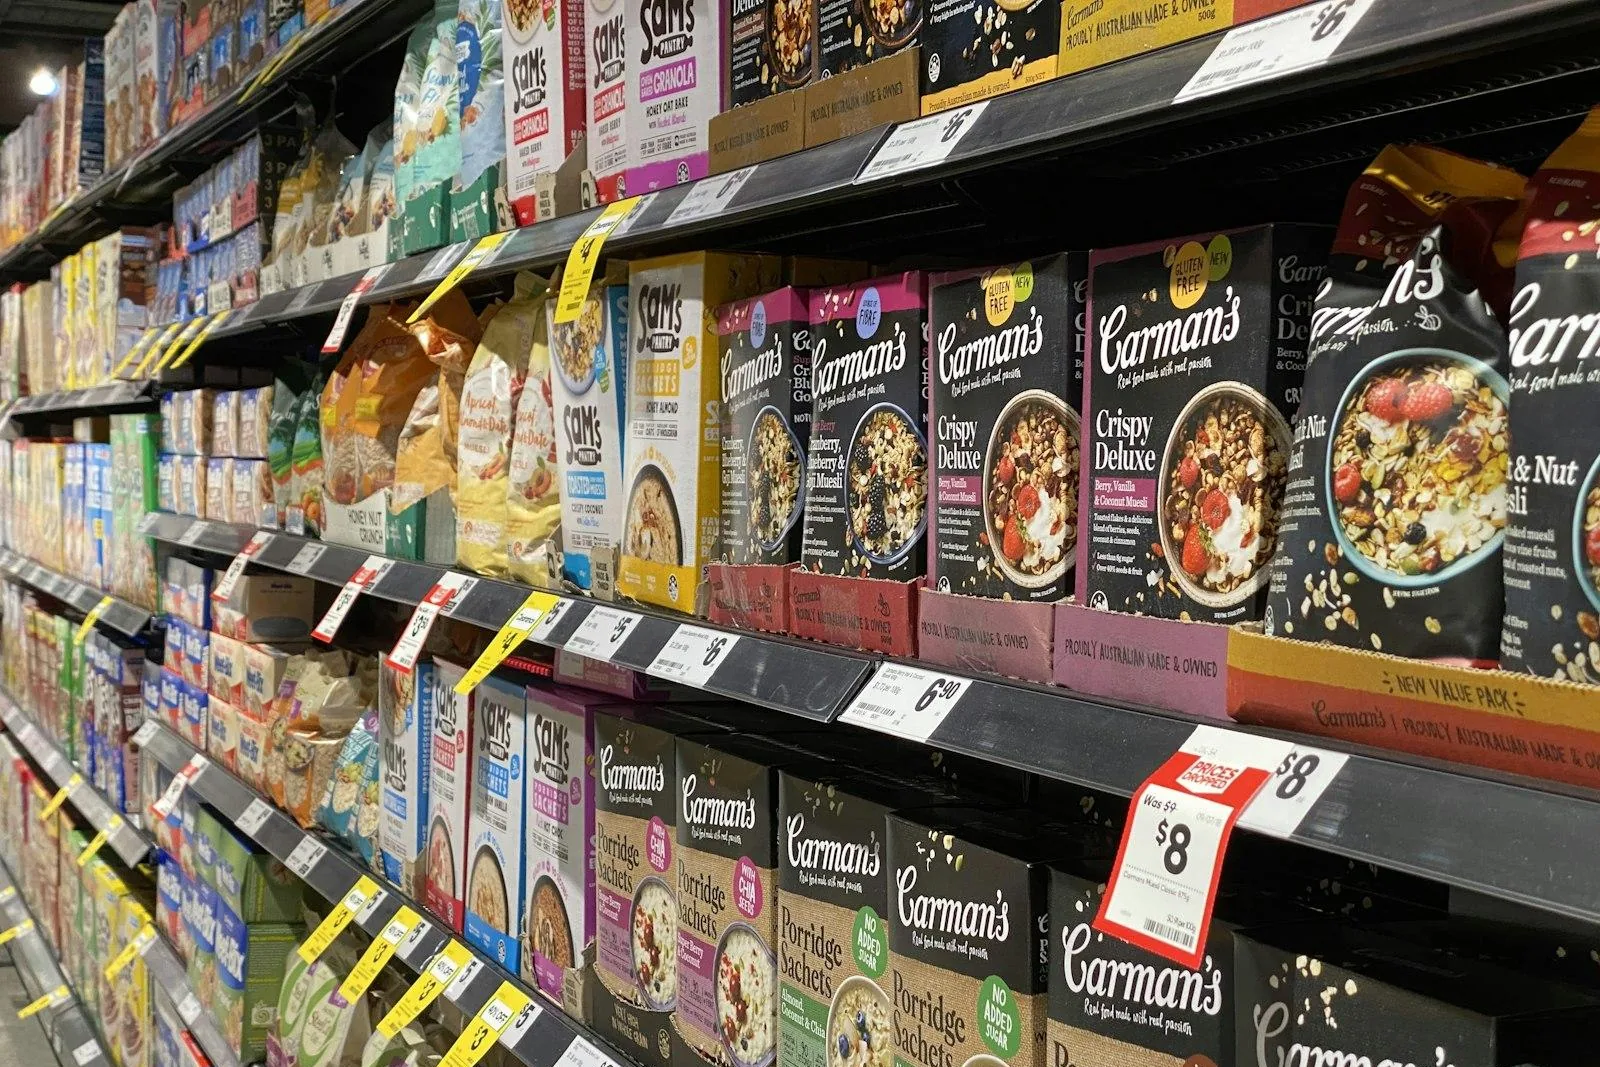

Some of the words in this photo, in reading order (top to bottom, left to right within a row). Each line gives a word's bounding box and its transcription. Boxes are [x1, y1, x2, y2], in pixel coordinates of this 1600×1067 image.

[1066, 25, 1093, 50] PROUDLY
[1096, 11, 1143, 41] AUSTRALIAN
[1144, 3, 1168, 25] MADE
[1171, 2, 1179, 16] &
[1197, 9, 1216, 22] 500g
[1310, 0, 1355, 42] $6
[660, 36, 685, 56] PANTRY
[653, 61, 694, 94] GRANOLA
[947, 90, 972, 107] Australian
[972, 86, 986, 99] made
[992, 79, 1011, 94] owned
[941, 108, 974, 143] $6
[1174, 255, 1204, 278] GLUTEN
[1209, 251, 1228, 266] NEW
[988, 280, 1011, 298] GLUTEN
[1014, 275, 1032, 289] NEW
[1175, 274, 1200, 297] FREE
[859, 310, 878, 328] FIBRE
[989, 295, 1009, 316] FREE
[1099, 285, 1241, 375] Carman's
[937, 305, 1043, 385] Carman's
[721, 333, 783, 404] Carman's
[811, 322, 907, 400] Carman's
[1174, 357, 1187, 374] real
[1187, 355, 1212, 375] passion
[1528, 366, 1559, 395] food
[1557, 360, 1584, 386] made
[660, 401, 679, 415] ALMOND
[937, 413, 979, 448] Crispy
[1095, 407, 1154, 447] Crispy
[837, 455, 846, 469] &
[937, 443, 982, 472] Deluxe
[1094, 440, 1156, 472] Deluxe
[1513, 454, 1531, 483] &
[1532, 455, 1579, 487] Nut
[816, 471, 843, 489] Muesli
[1094, 479, 1113, 493] Berry,
[1113, 480, 1136, 493] Vanilla
[1093, 495, 1100, 506] &
[1100, 495, 1125, 508] Coconut
[1125, 496, 1148, 509] Muesli
[368, 511, 383, 526] NUT
[359, 529, 384, 545] CRUNCH
[609, 615, 634, 643] $5
[920, 618, 943, 638] PROUDLY
[943, 624, 977, 645] AUSTRALIAN
[1003, 632, 1030, 652] OWNED
[702, 636, 728, 667] $6
[1064, 638, 1099, 659] PROUDLY
[1099, 643, 1146, 668] AUSTRALIAN
[1147, 653, 1170, 672] MADE
[1172, 659, 1181, 673] &
[1182, 658, 1219, 679] OWNED
[1396, 675, 1427, 696] NEW
[1429, 677, 1473, 703] VALUE
[1476, 684, 1514, 712] PACK
[1311, 698, 1387, 730] Carman's
[1402, 716, 1452, 744] PROUDLY
[1455, 726, 1528, 758] AUSTRALIAN
[1533, 745, 1568, 764] MADE
[600, 744, 665, 793] Carman's
[1180, 770, 1229, 791] DROPPED
[1189, 760, 1240, 780] PRICES
[1275, 751, 1321, 801] $8
[534, 793, 568, 822] SACHETS
[682, 773, 756, 830] Carman's
[1142, 793, 1162, 811] Was
[1163, 800, 1178, 815] $9
[598, 822, 640, 871] Porridge
[650, 834, 667, 858] CHIA
[787, 812, 881, 878] Carman's
[1155, 817, 1192, 876] $8
[650, 852, 665, 870] SEEDS
[741, 862, 756, 884] WITH
[678, 857, 726, 914] Porridge
[738, 877, 757, 903] CHIA
[1145, 878, 1161, 892] Muesli
[1160, 882, 1178, 897] Classic
[738, 896, 756, 917] SEEDS
[896, 864, 1009, 943] Carman's
[677, 902, 717, 942] Sachets
[864, 912, 877, 934] NO
[781, 905, 843, 972] Porridge
[857, 927, 881, 958] ADDED
[911, 930, 924, 947] Real
[923, 932, 934, 951] food
[933, 938, 946, 952] made
[945, 939, 957, 955] with
[956, 942, 968, 956] real
[967, 945, 989, 962] passion
[780, 940, 834, 1000] Sachets
[858, 947, 878, 973] SUGAR
[1061, 923, 1223, 1016] Carman's
[418, 979, 437, 1002] $3
[781, 987, 805, 1014] Almond,
[991, 982, 1008, 1007] NO
[515, 1002, 536, 1029] $5
[781, 1001, 805, 1027] Coconut
[810, 1020, 826, 1040] Chia
[892, 967, 967, 1045] Porridge
[983, 1001, 1014, 1035] ADDED
[1083, 996, 1101, 1017] Real
[1100, 1002, 1117, 1023] food
[1115, 1007, 1131, 1023] made
[1131, 1008, 1148, 1027] with
[1147, 1011, 1164, 1029] real
[1164, 1016, 1193, 1038] passion
[470, 1024, 489, 1051] $3
[892, 1008, 954, 1067] Sachets
[985, 1023, 1010, 1052] SUGAR
